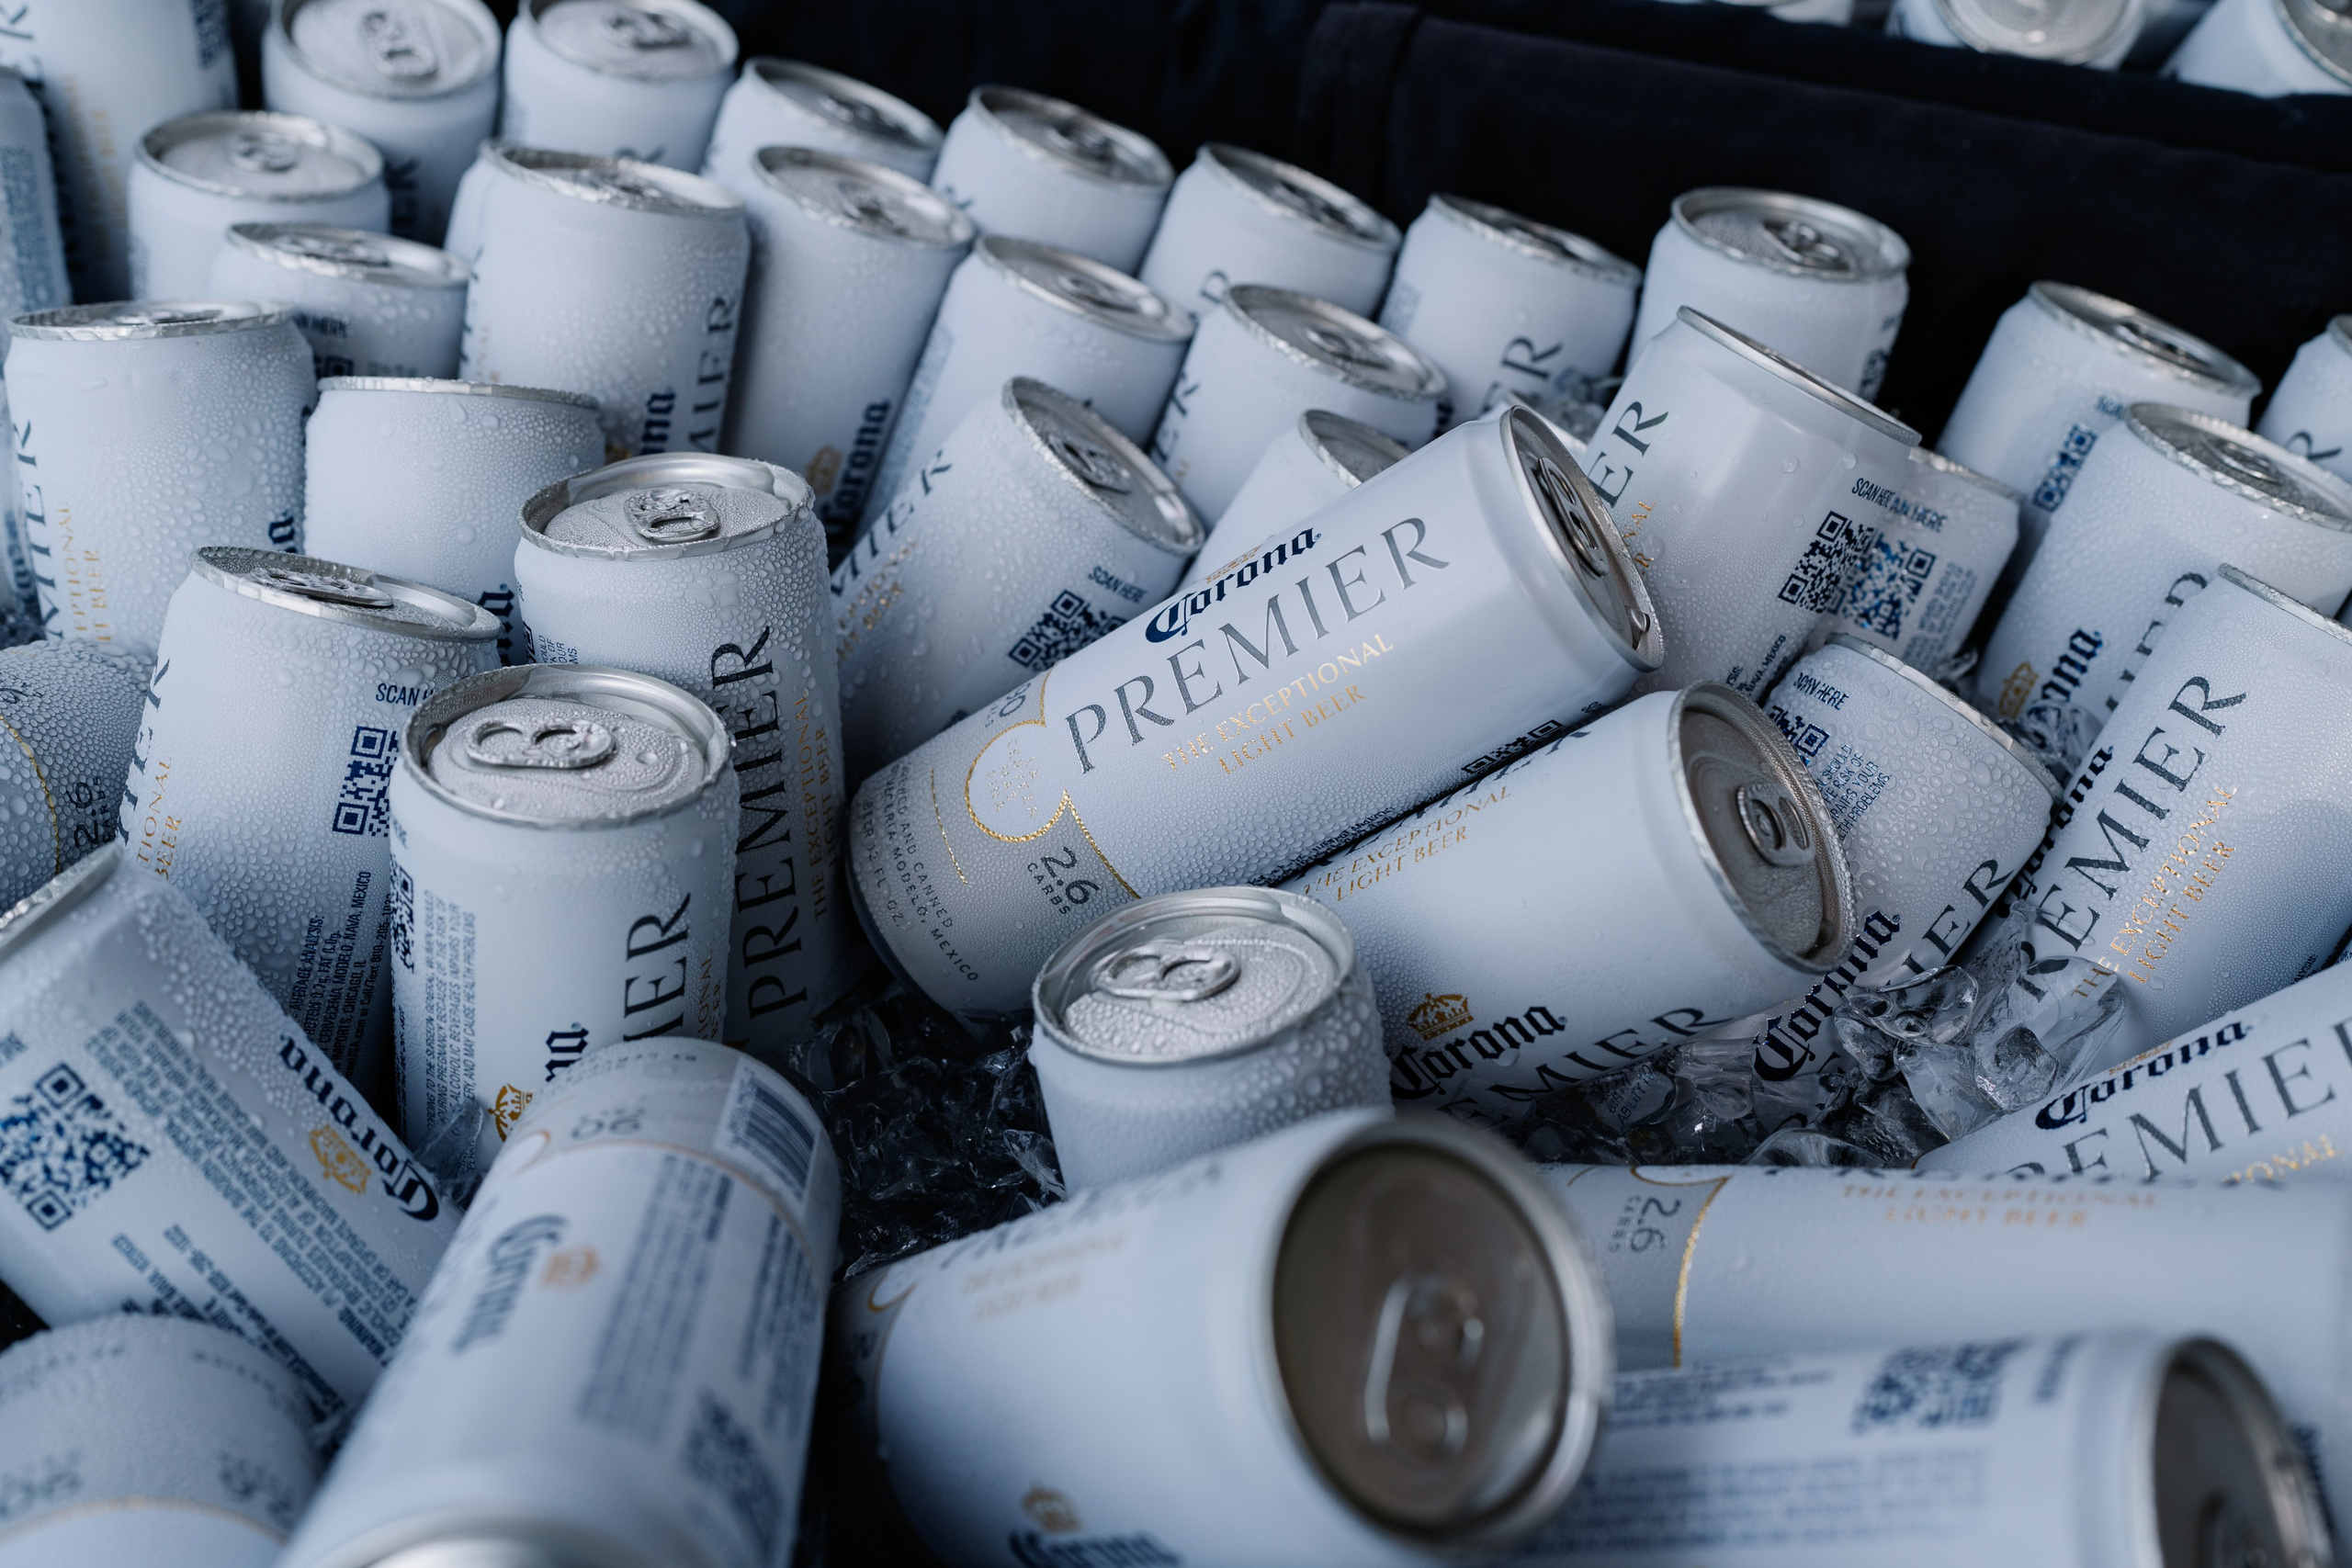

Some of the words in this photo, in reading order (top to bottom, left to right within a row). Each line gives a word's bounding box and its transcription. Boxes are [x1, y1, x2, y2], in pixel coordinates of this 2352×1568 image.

[1851, 478, 1880, 503] SCAN
[1146, 526, 1317, 643] Corona
[1065, 516, 1450, 774] PREMIER
[1762, 633, 1787, 668] MEXICO
[376, 682, 420, 706] SCAN
[1161, 731, 1214, 773] THE
[1208, 633, 1395, 750] EXCEPTIONAL
[1815, 683, 1849, 711] HERE
[814, 722, 830, 785] BEER
[1216, 718, 1298, 775] LIGHT
[1300, 682, 1367, 734] BEER
[794, 689, 824, 869] EXCEPTIONAL
[1822, 744, 1852, 781] SHOULD
[1833, 766, 1856, 789] RISK
[1850, 750, 1865, 768] OF
[1852, 761, 1879, 789] YOUR
[711, 625, 807, 1020] PREMIER
[1351, 785, 1511, 874] EXCEPTIONAL
[2016, 675, 2247, 1002] REMIER
[350, 869, 372, 909] MEXICO
[899, 821, 917, 856] AND
[911, 862, 955, 930] CANNED
[1026, 862, 1071, 916] CARBS
[1040, 846, 1101, 906] 2.6
[1336, 855, 1408, 903] LIGHT
[1413, 825, 1469, 865] BEER
[2071, 956, 2120, 998] THE
[2110, 785, 2238, 956] EXCEPTIONAL
[299, 912, 324, 965] ANALYSIS:
[343, 908, 363, 942] NAVA,
[2128, 902, 2190, 985] LIGHT
[2182, 840, 2236, 903] BEER
[333, 940, 356, 986] MODELO,
[929, 927, 979, 983] MEXICO
[288, 964, 312, 1011] AVERAGE
[303, 999, 322, 1034] ROTEIN
[318, 955, 334, 973] FAT
[343, 967, 365, 1014] CHICAGO,
[354, 957, 367, 967] IL
[358, 962, 379, 1007] Call/Text
[434, 979, 448, 1022] BECAUSE
[444, 981, 464, 1042] BEVERAGES
[460, 965, 477, 1004] HEALTH
[1754, 910, 1899, 1082] Corona
[319, 987, 344, 1043] CERVECERIA
[422, 1015, 437, 1059] SURGEON
[462, 1005, 477, 1036] CAUSE
[424, 1059, 435, 1077] THE
[432, 1023, 451, 1082] PREGNANCY
[445, 1043, 464, 1101] ALCOHOLIC
[463, 1036, 476, 1058] MAY
[463, 1058, 476, 1079] AND
[1390, 1005, 1566, 1100] Corona
[424, 1077, 435, 1089] TO
[2035, 1020, 2250, 1131] Corona
[280, 1036, 440, 1222] Corona
